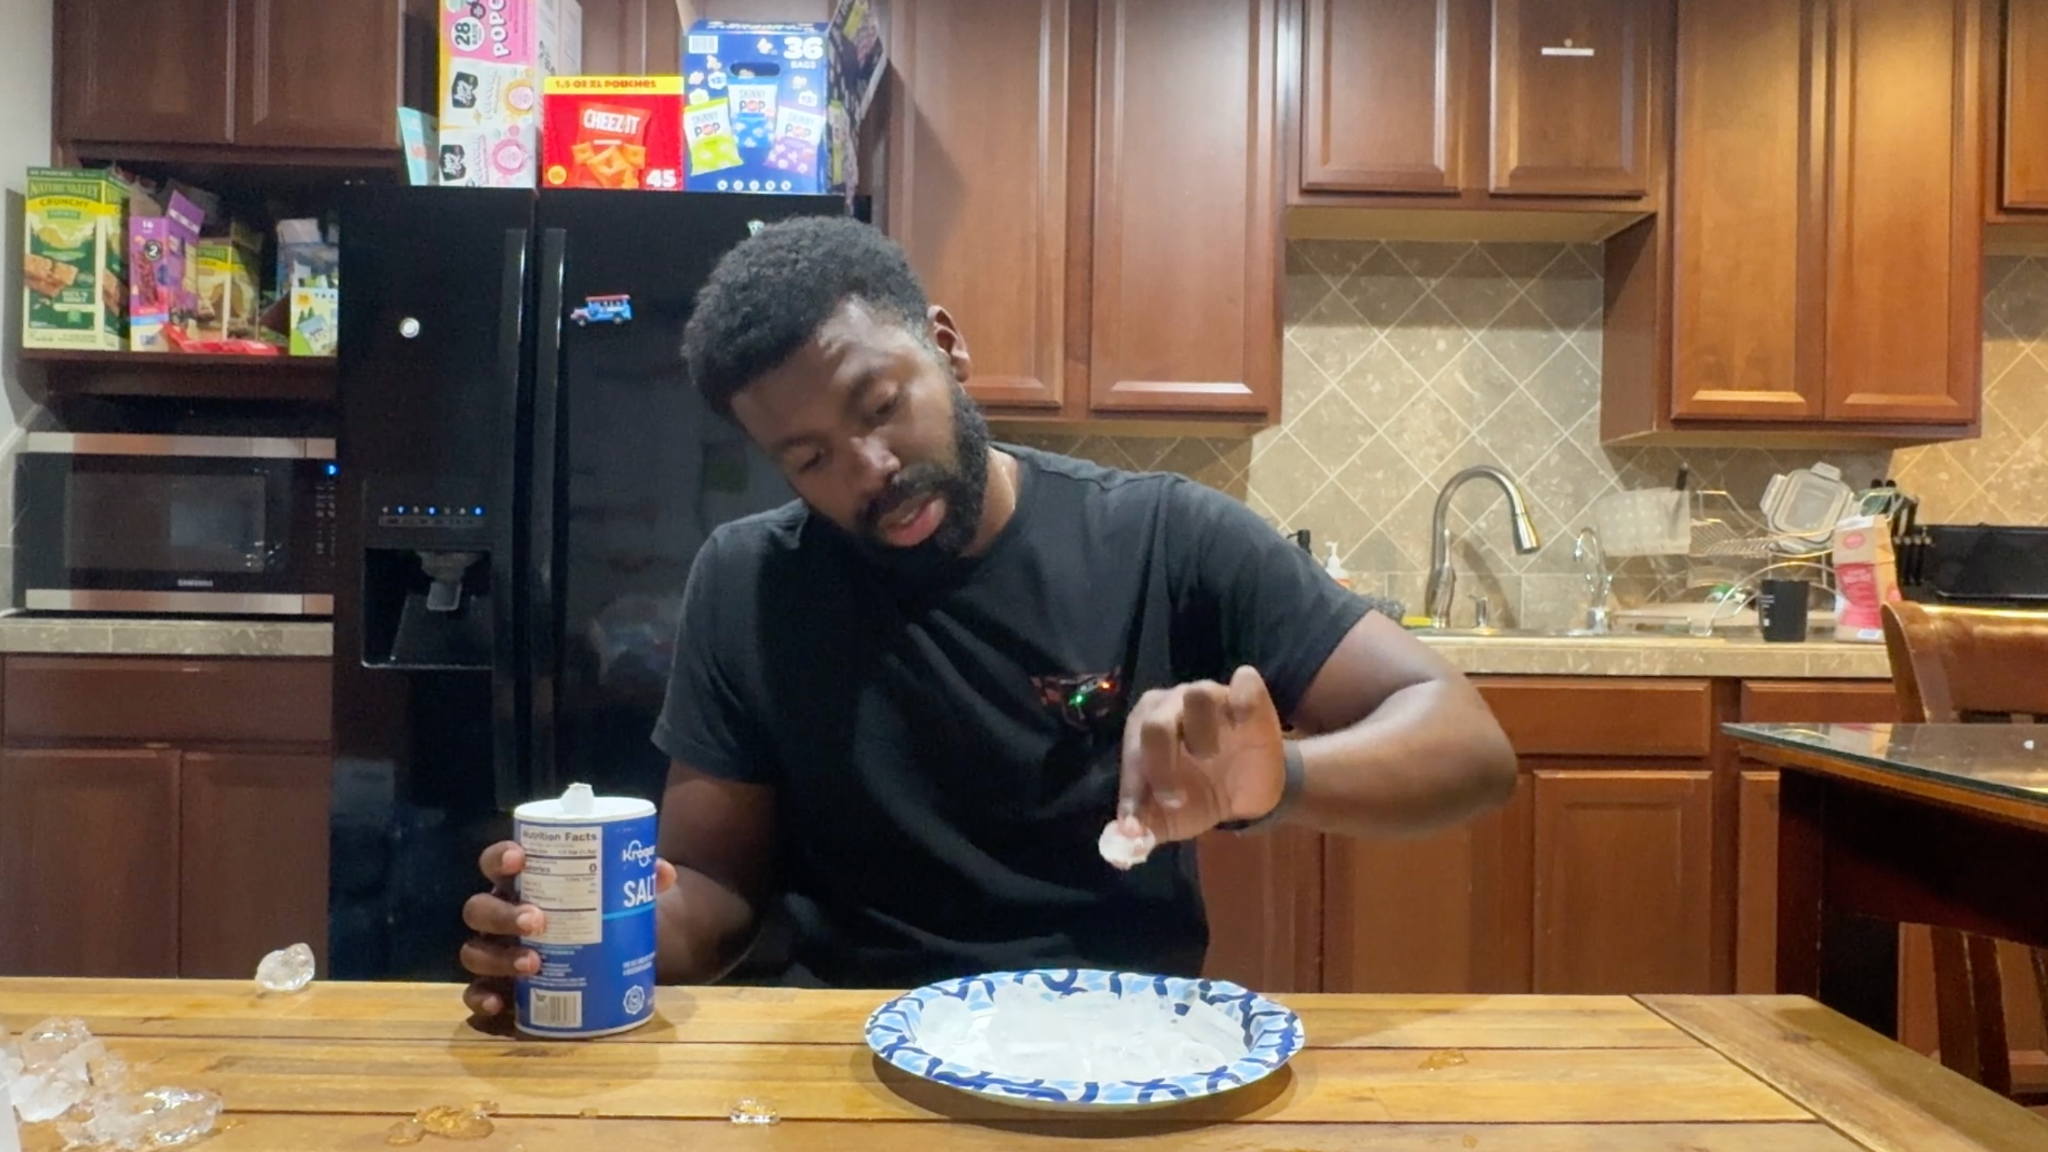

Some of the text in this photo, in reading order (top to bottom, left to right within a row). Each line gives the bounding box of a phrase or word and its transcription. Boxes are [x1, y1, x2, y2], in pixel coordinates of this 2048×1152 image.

[454, 22, 471, 46] 28
[783, 37, 823, 60] 36
[791, 61, 816, 69] BAGS
[555, 80, 570, 88] 1.5
[589, 80, 603, 88] XL
[739, 100, 766, 113] POP
[694, 122, 721, 138] POP
[785, 123, 812, 139] POP
[646, 169, 677, 187] 45
[39, 198, 90, 209] CRUNCHY
[565, 832, 597, 842] Facts
